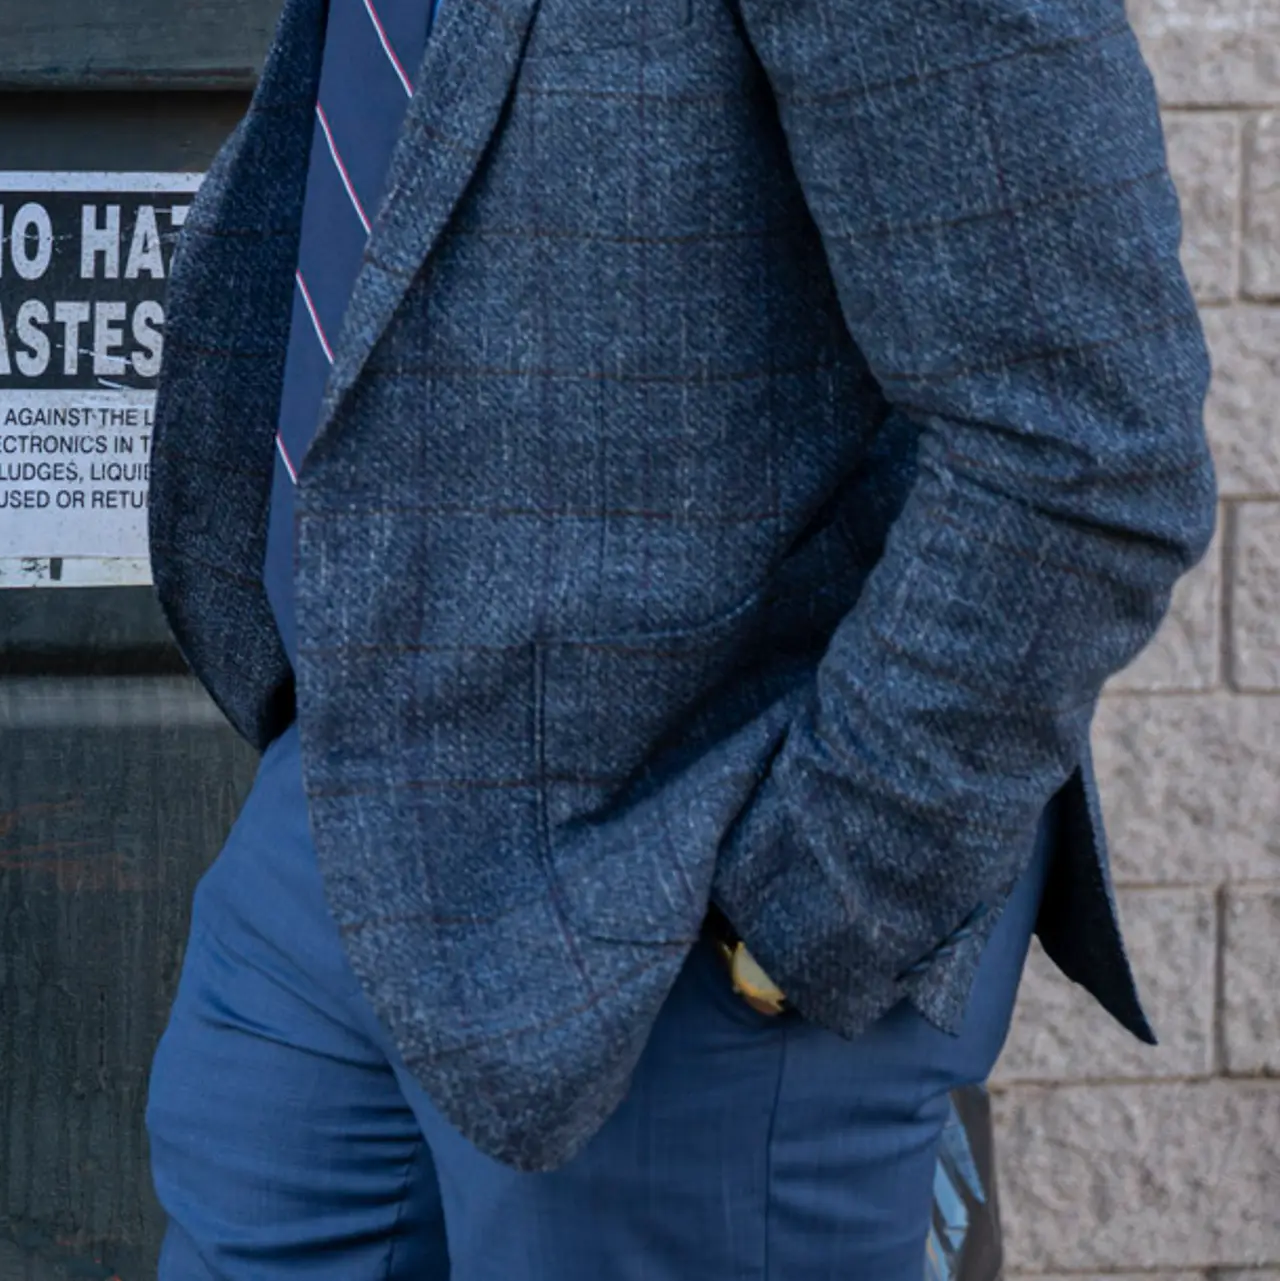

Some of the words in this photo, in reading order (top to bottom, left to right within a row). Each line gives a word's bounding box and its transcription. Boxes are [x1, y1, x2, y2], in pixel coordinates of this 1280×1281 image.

[4, 407, 96, 426] AGAINST
[98, 408, 138, 426] THE
[114, 436, 133, 453] IN
[56, 490, 85, 509] OR
[91, 490, 149, 509] RETU
